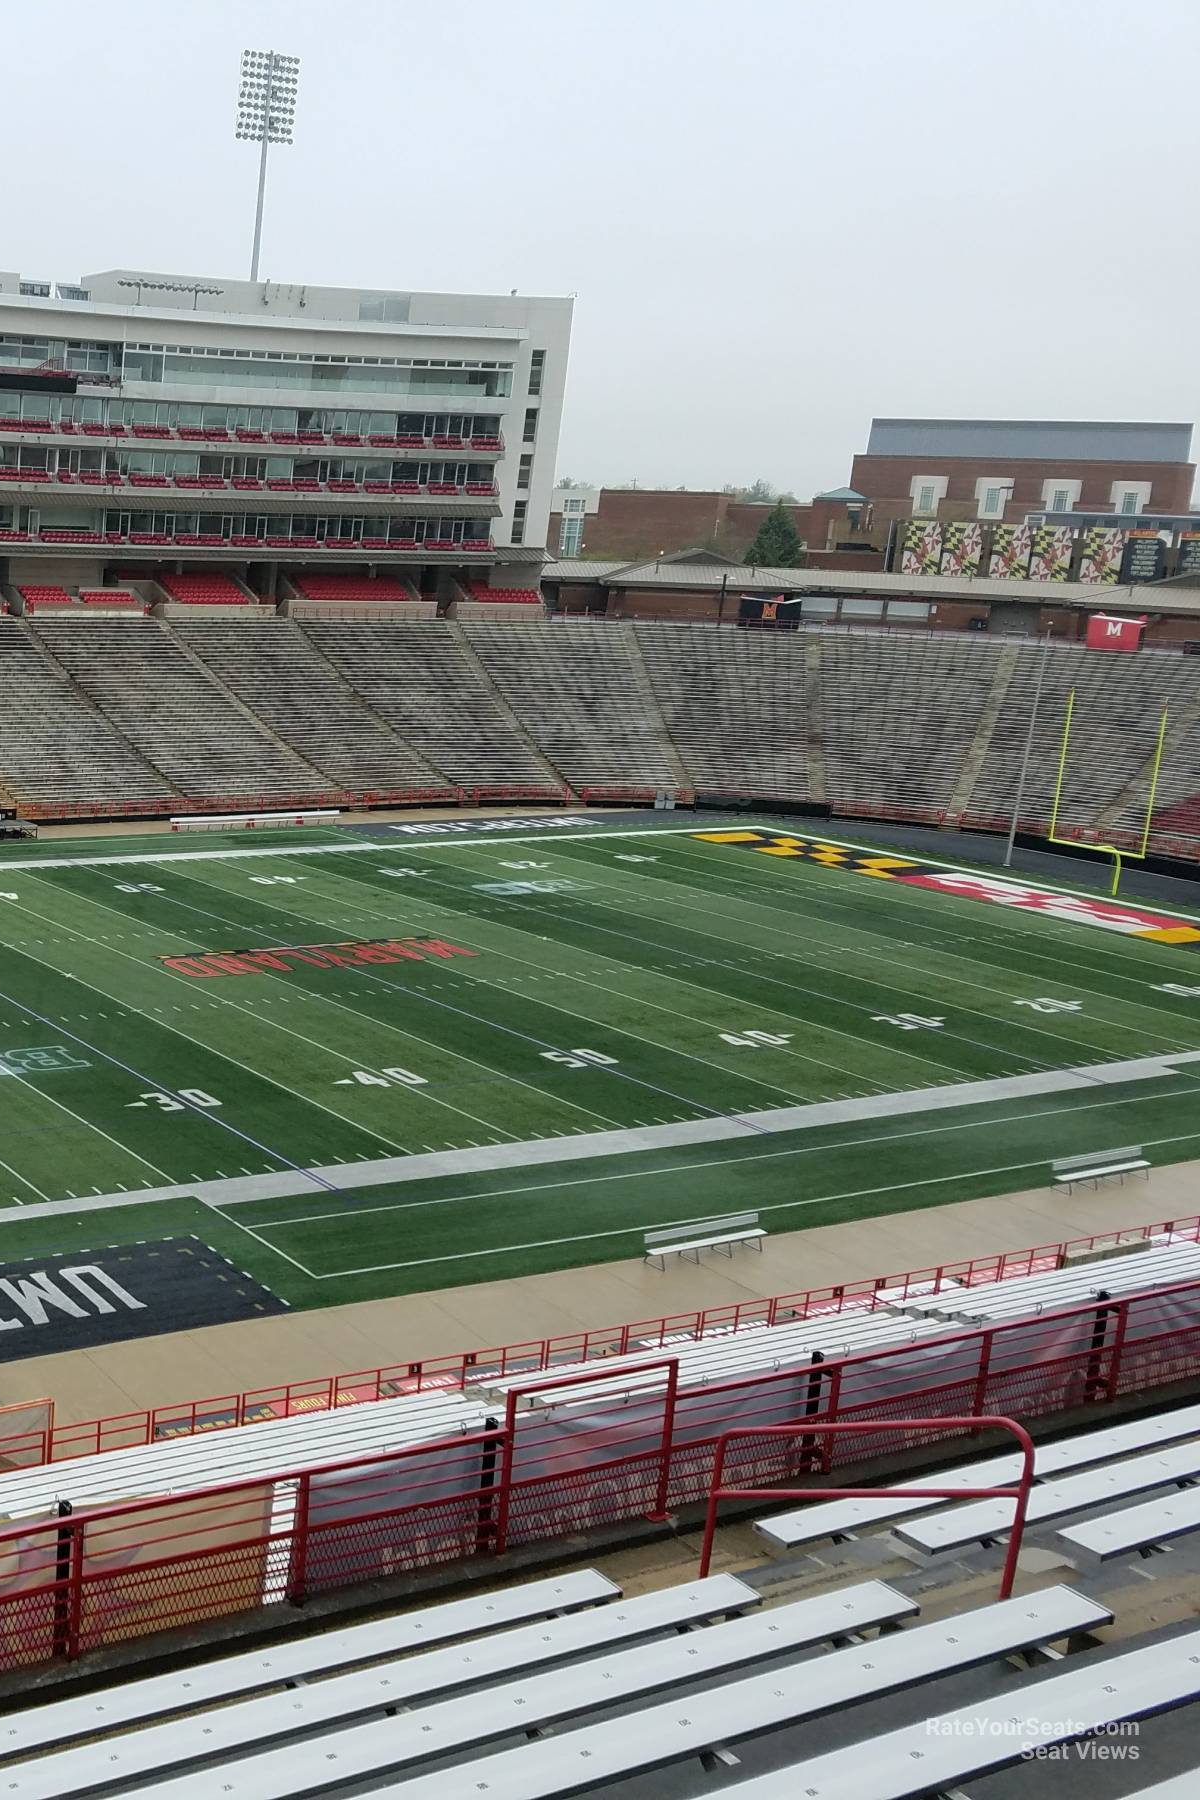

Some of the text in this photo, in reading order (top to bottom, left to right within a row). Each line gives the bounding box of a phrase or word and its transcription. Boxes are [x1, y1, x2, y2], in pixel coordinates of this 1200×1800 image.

[1105, 621, 1123, 637] M
[113, 883, 166, 893] 50
[718, 1030, 790, 1047] 40
[539, 1048, 620, 1069] 50
[352, 1067, 429, 1087] 40
[139, 1088, 223, 1112] 30
